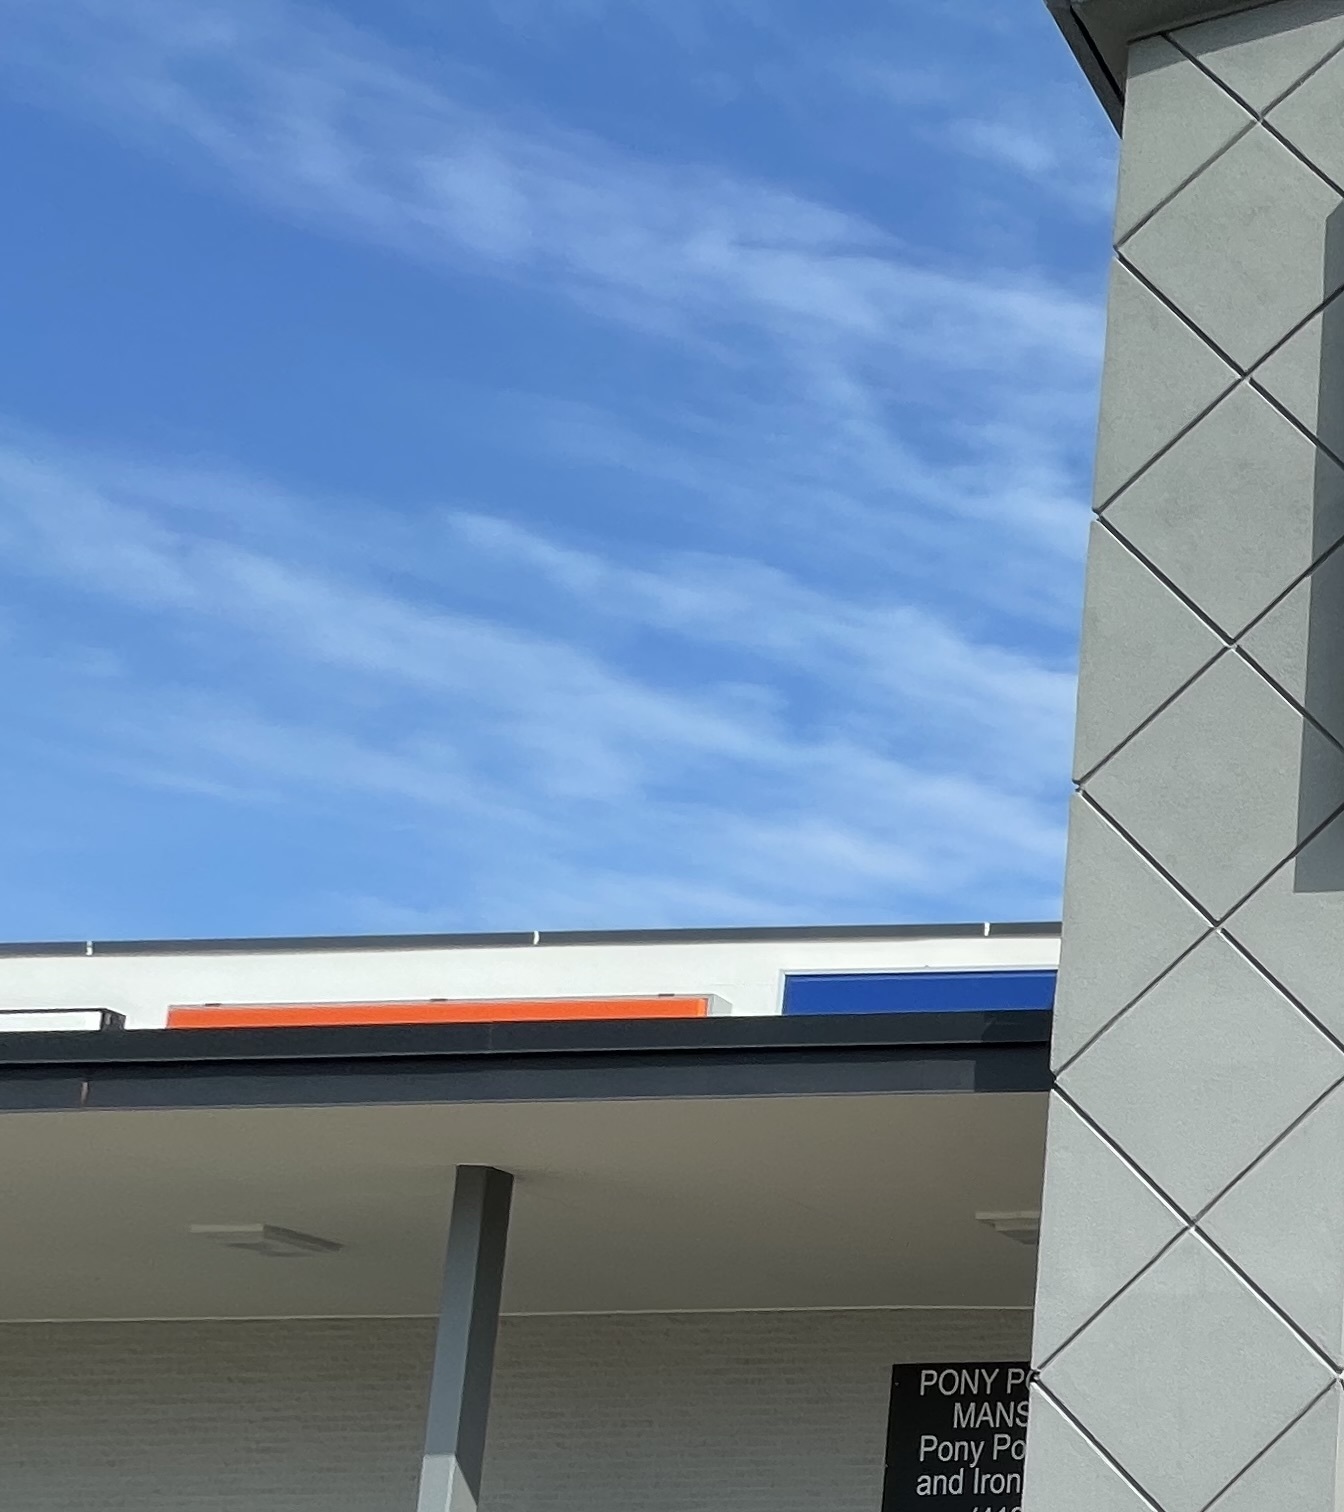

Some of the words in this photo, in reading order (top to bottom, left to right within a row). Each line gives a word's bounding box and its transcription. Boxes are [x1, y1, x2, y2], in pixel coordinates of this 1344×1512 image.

[920, 1368, 999, 1396] PONY
[953, 1401, 1030, 1428] MANS
[919, 1434, 984, 1468] Pony
[993, 1433, 1027, 1461] Po
[916, 1468, 965, 1495] and
[973, 1467, 1022, 1494] Iron
